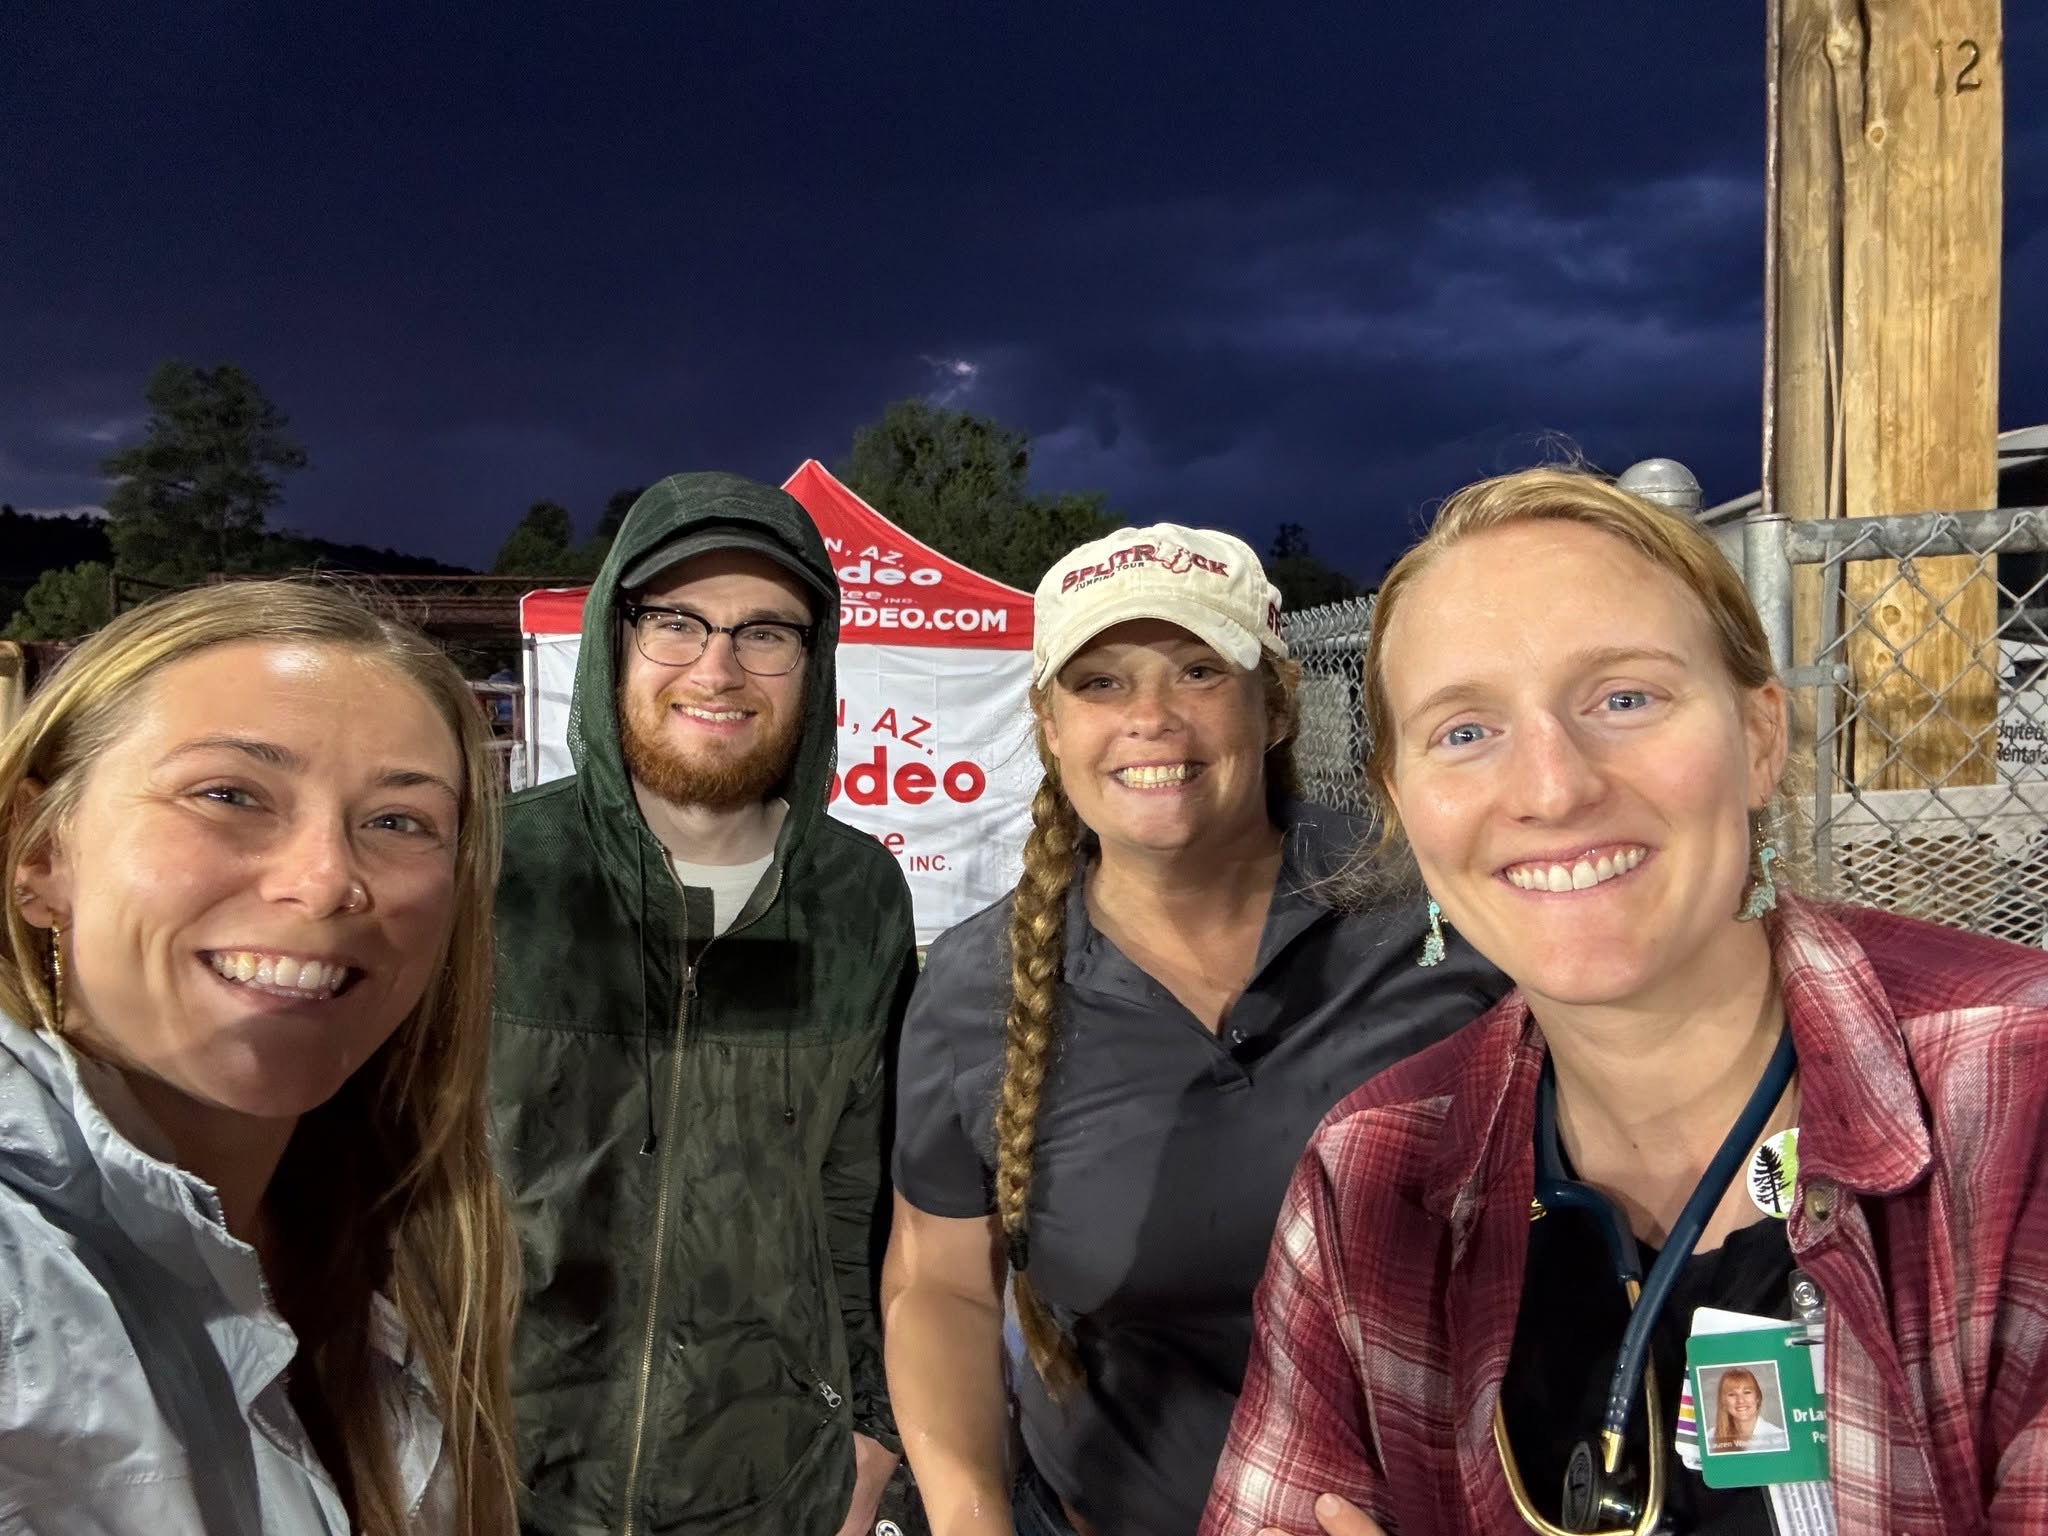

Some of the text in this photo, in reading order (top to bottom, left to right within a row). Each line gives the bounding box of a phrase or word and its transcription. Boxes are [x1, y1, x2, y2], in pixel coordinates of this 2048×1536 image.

[860, 545, 904, 568] AZ.
[1116, 562, 1145, 572] TOUR
[833, 560, 942, 586] deo
[871, 707, 934, 755] AZ.
[829, 745, 986, 806] deo
[909, 855, 952, 872] INC.
[1793, 1407, 1827, 1422] Dr La
